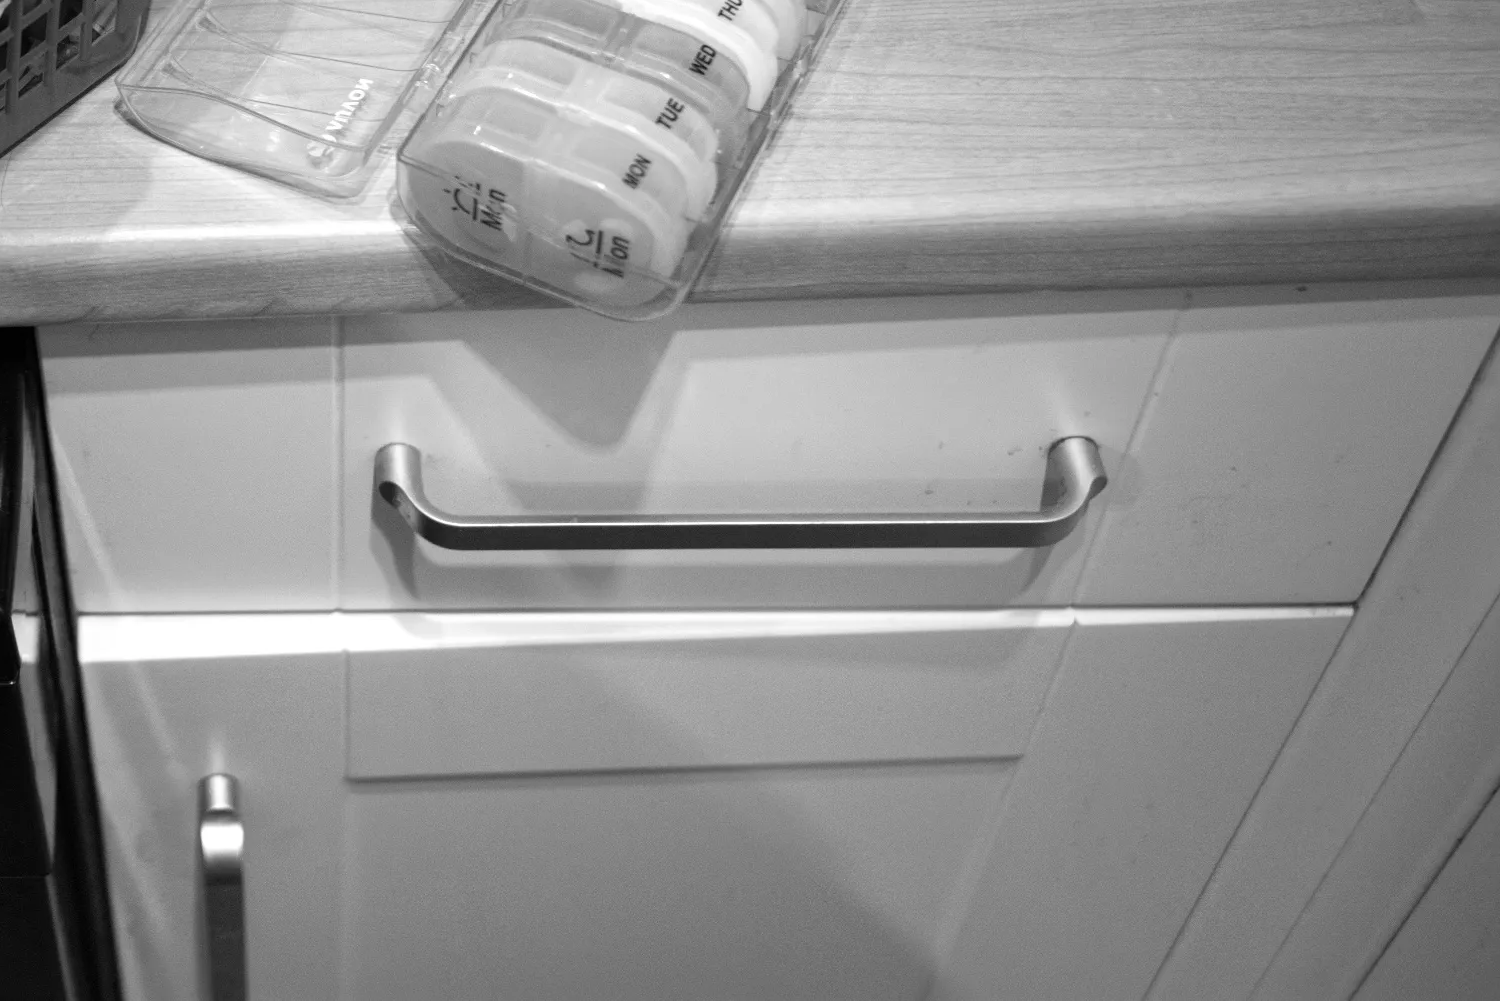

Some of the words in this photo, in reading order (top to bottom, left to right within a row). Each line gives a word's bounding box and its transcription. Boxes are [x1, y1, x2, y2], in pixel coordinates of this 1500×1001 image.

[688, 44, 718, 75] WED
[654, 98, 685, 130] TUE
[623, 154, 653, 190] MON
